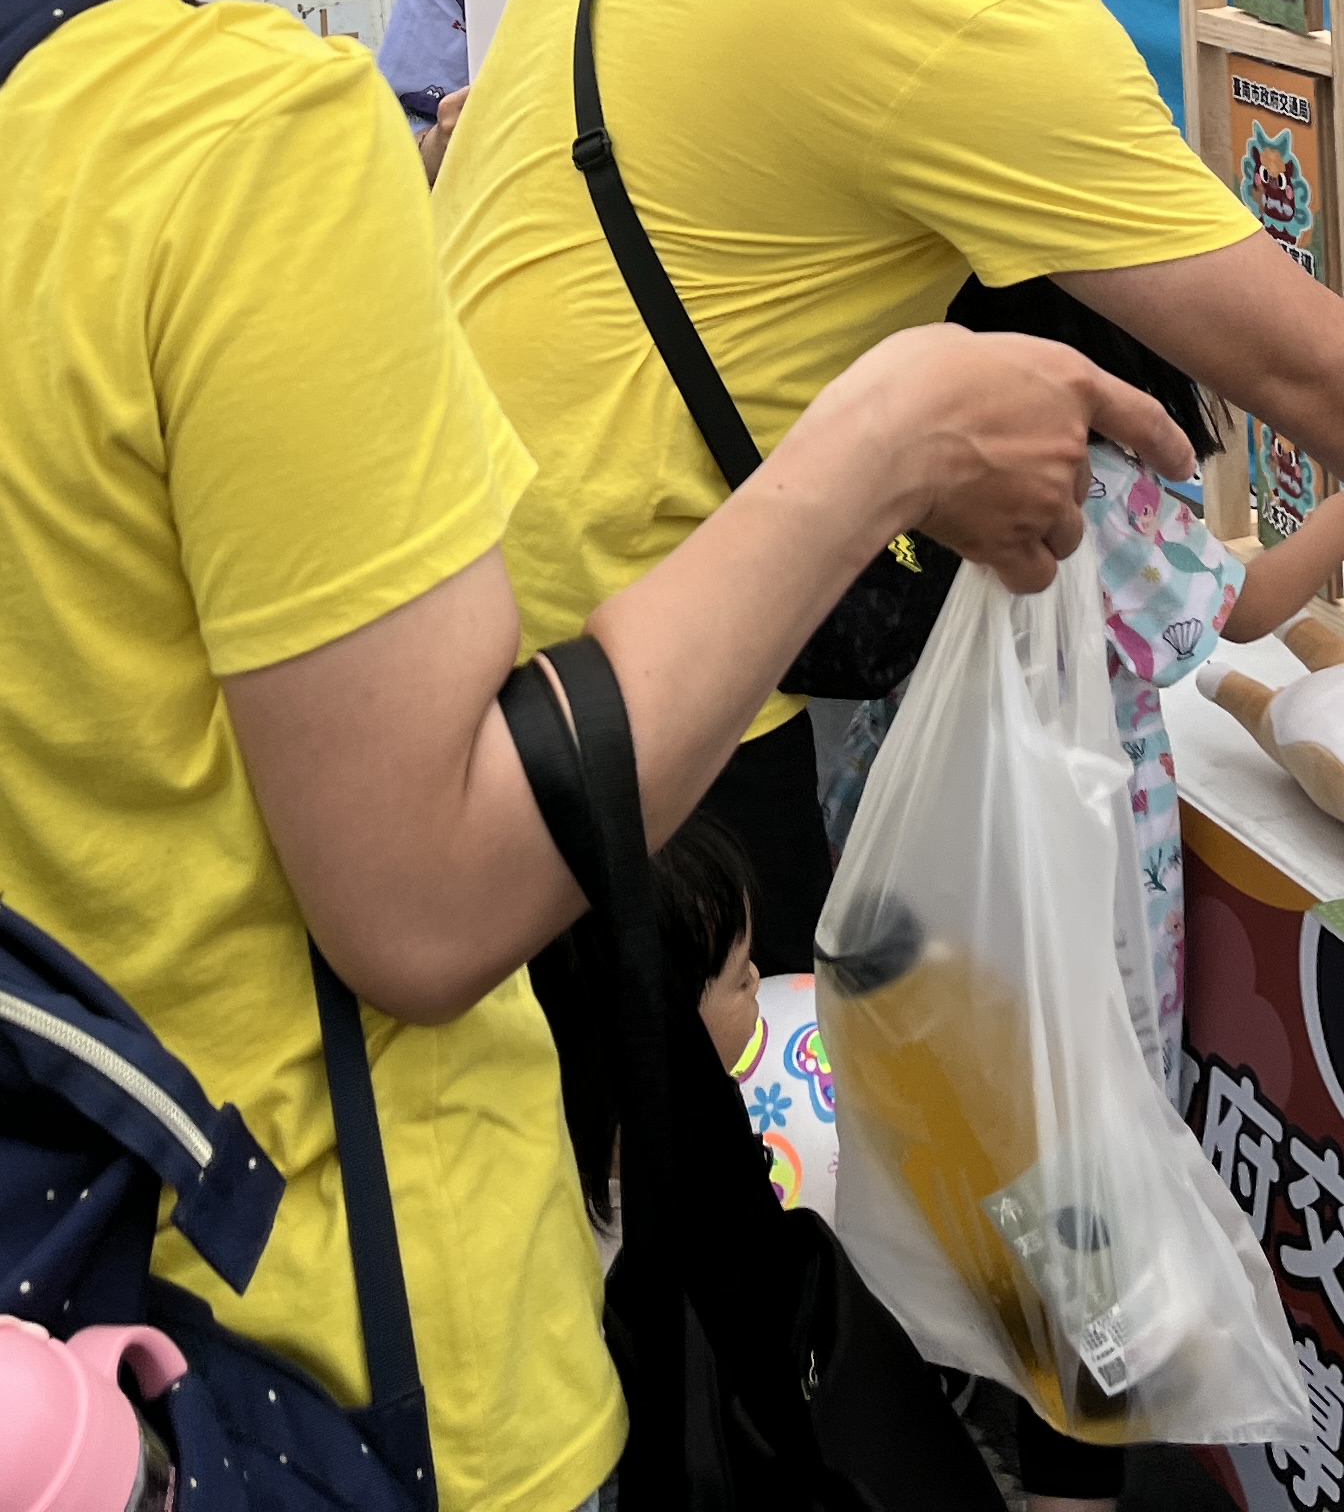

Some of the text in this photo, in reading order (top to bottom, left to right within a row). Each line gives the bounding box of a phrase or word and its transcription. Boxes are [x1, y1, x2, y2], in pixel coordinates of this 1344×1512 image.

[1233, 75, 1310, 122] 臺南市政府交通局
